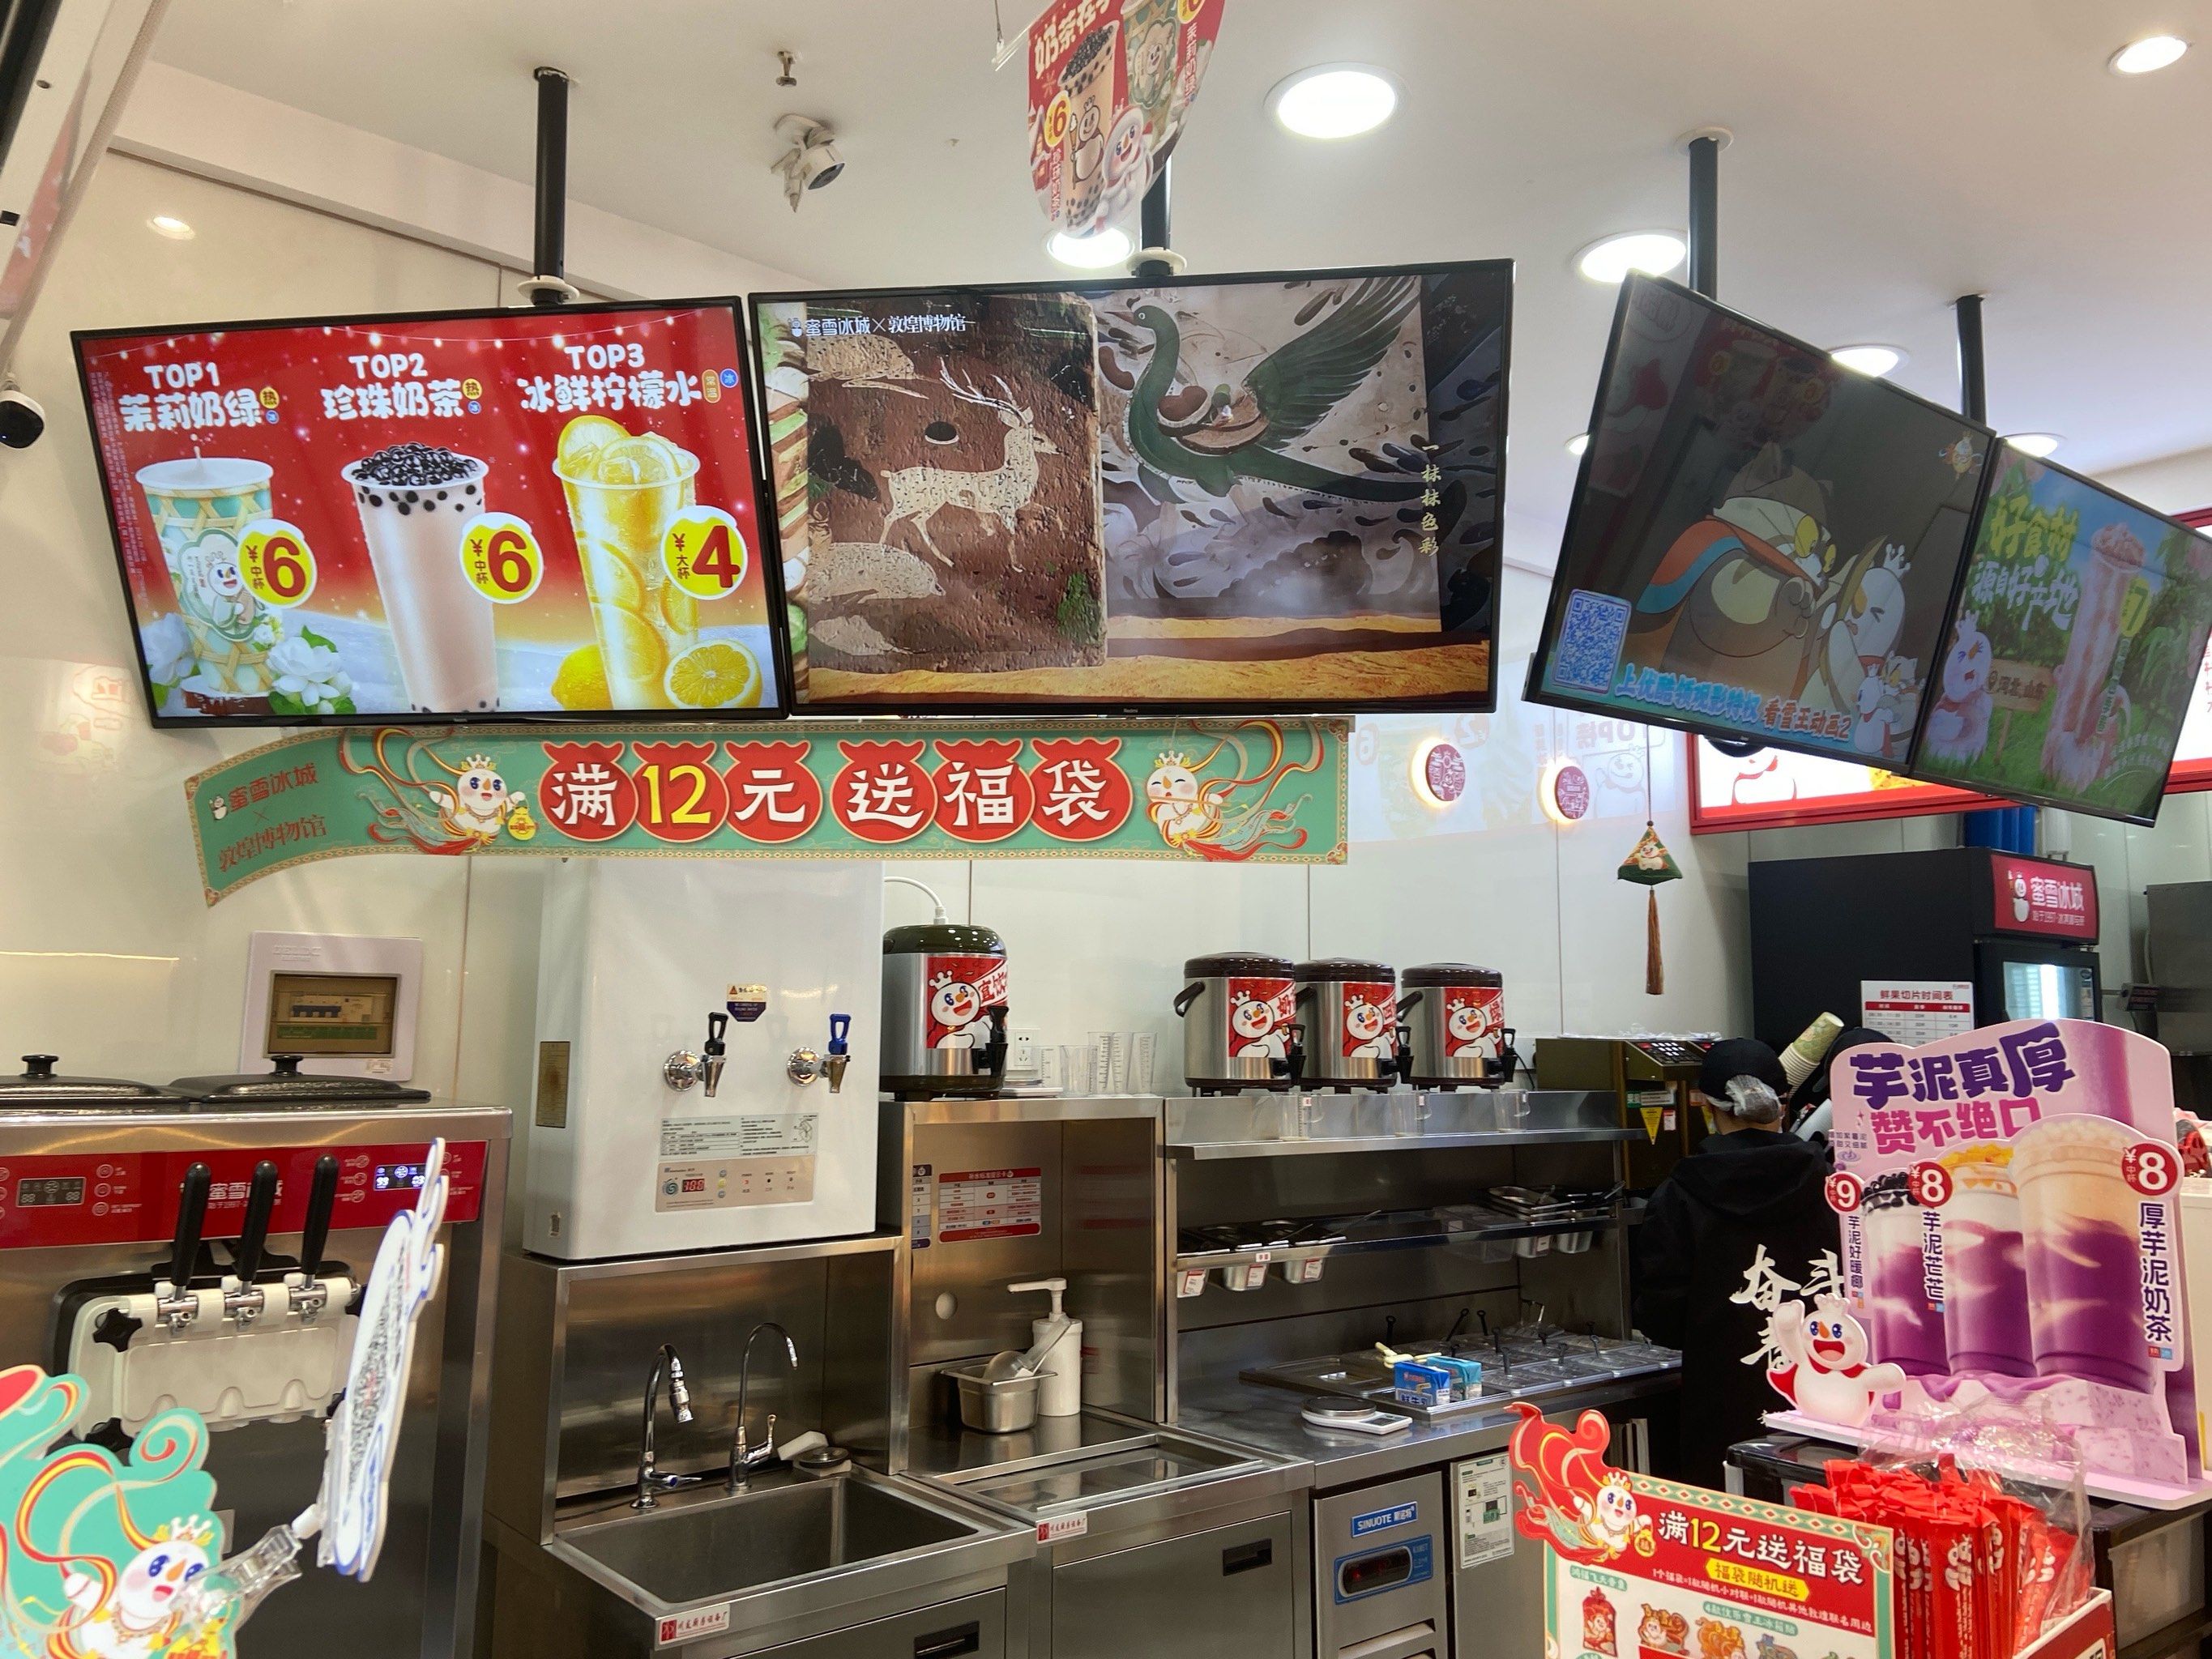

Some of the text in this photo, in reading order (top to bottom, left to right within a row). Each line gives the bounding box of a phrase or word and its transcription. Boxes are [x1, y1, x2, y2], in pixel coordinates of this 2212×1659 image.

[1035, 0, 1110, 79] 奶茶在
[1053, 100, 1067, 137] 6
[143, 362, 220, 389] TOP1
[348, 353, 428, 379] TOP2
[564, 343, 645, 369] TOP3
[118, 388, 262, 432] 茉莉奶绿
[320, 378, 464, 420] 珍珠奶茶
[516, 370, 702, 412] 冰鲜柠檬水
[1990, 494, 2079, 561] 好食材
[263, 537, 306, 597] 6
[488, 531, 532, 592] 6
[692, 525, 741, 588] 4
[228, 763, 318, 812] 蜜雪冰城
[220, 814, 327, 872] 敦煌博物馆
[2030, 876, 2085, 911] 蜜雪冰城
[1880, 990, 1954, 1000] 鲜果切片时间表
[1851, 1023, 2076, 1110] 芋泥真厚
[1870, 1097, 2042, 1154] 赞不绝口
[209, 1180, 283, 1200] 蜜雪
[1921, 1169, 1945, 1202] 8
[2138, 1152, 2168, 1190] 8
[1836, 1179, 1856, 1208] 9
[1923, 1211, 1944, 1300] 芋泥芒芒
[2141, 1203, 2172, 1342] 厚芋泥奶茶
[1658, 1510, 1864, 1584] 满12元送福袋
[1715, 1561, 1800, 1597] 福袋随机送
